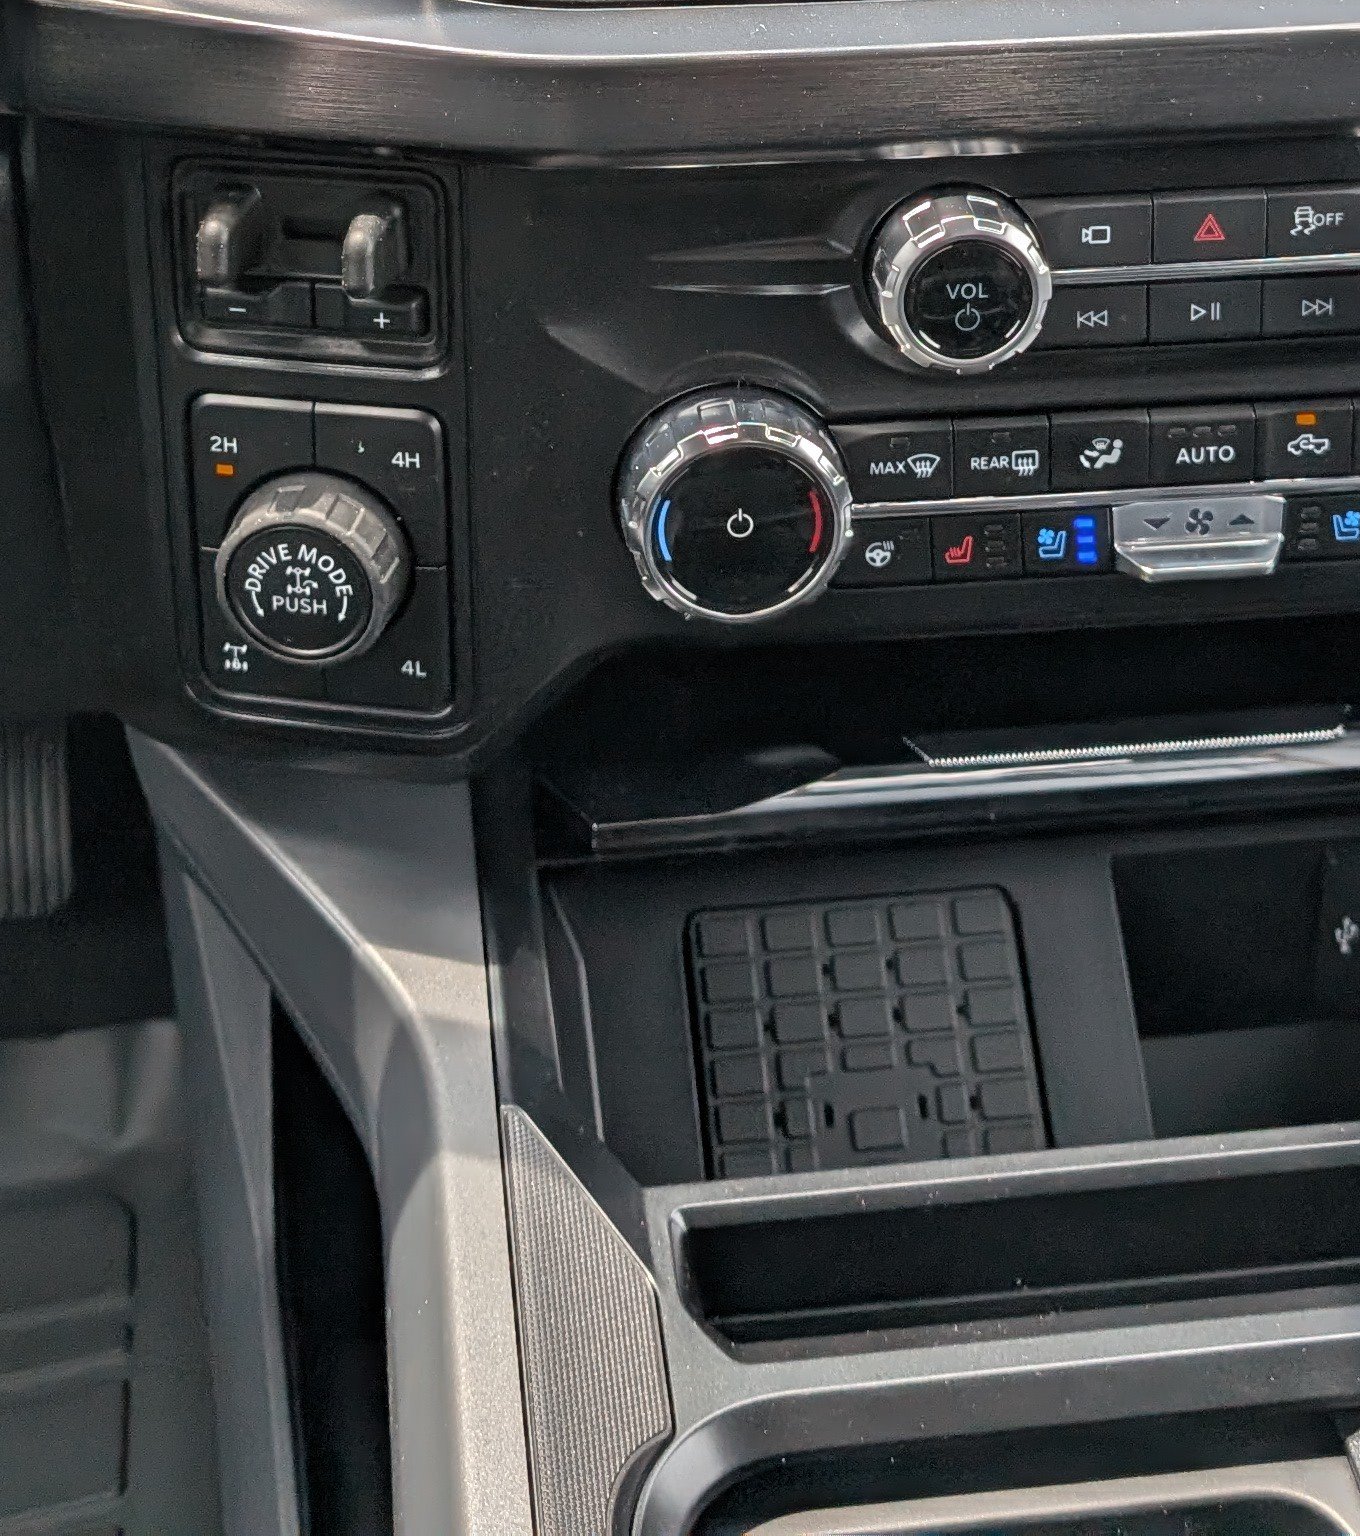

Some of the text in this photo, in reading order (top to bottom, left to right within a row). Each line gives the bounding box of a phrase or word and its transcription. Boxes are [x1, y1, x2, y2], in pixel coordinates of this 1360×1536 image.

[1314, 212, 1344, 227] OFF
[945, 282, 990, 301] VOL
[209, 435, 238, 454] 2H
[390, 451, 422, 470] 4H
[970, 456, 1010, 472] REAR
[1176, 445, 1236, 465] AUTO
[869, 460, 907, 476] MAX
[244, 542, 354, 598] DRIVE MODE
[270, 594, 328, 615] PUSH
[400, 659, 428, 679] 4L
